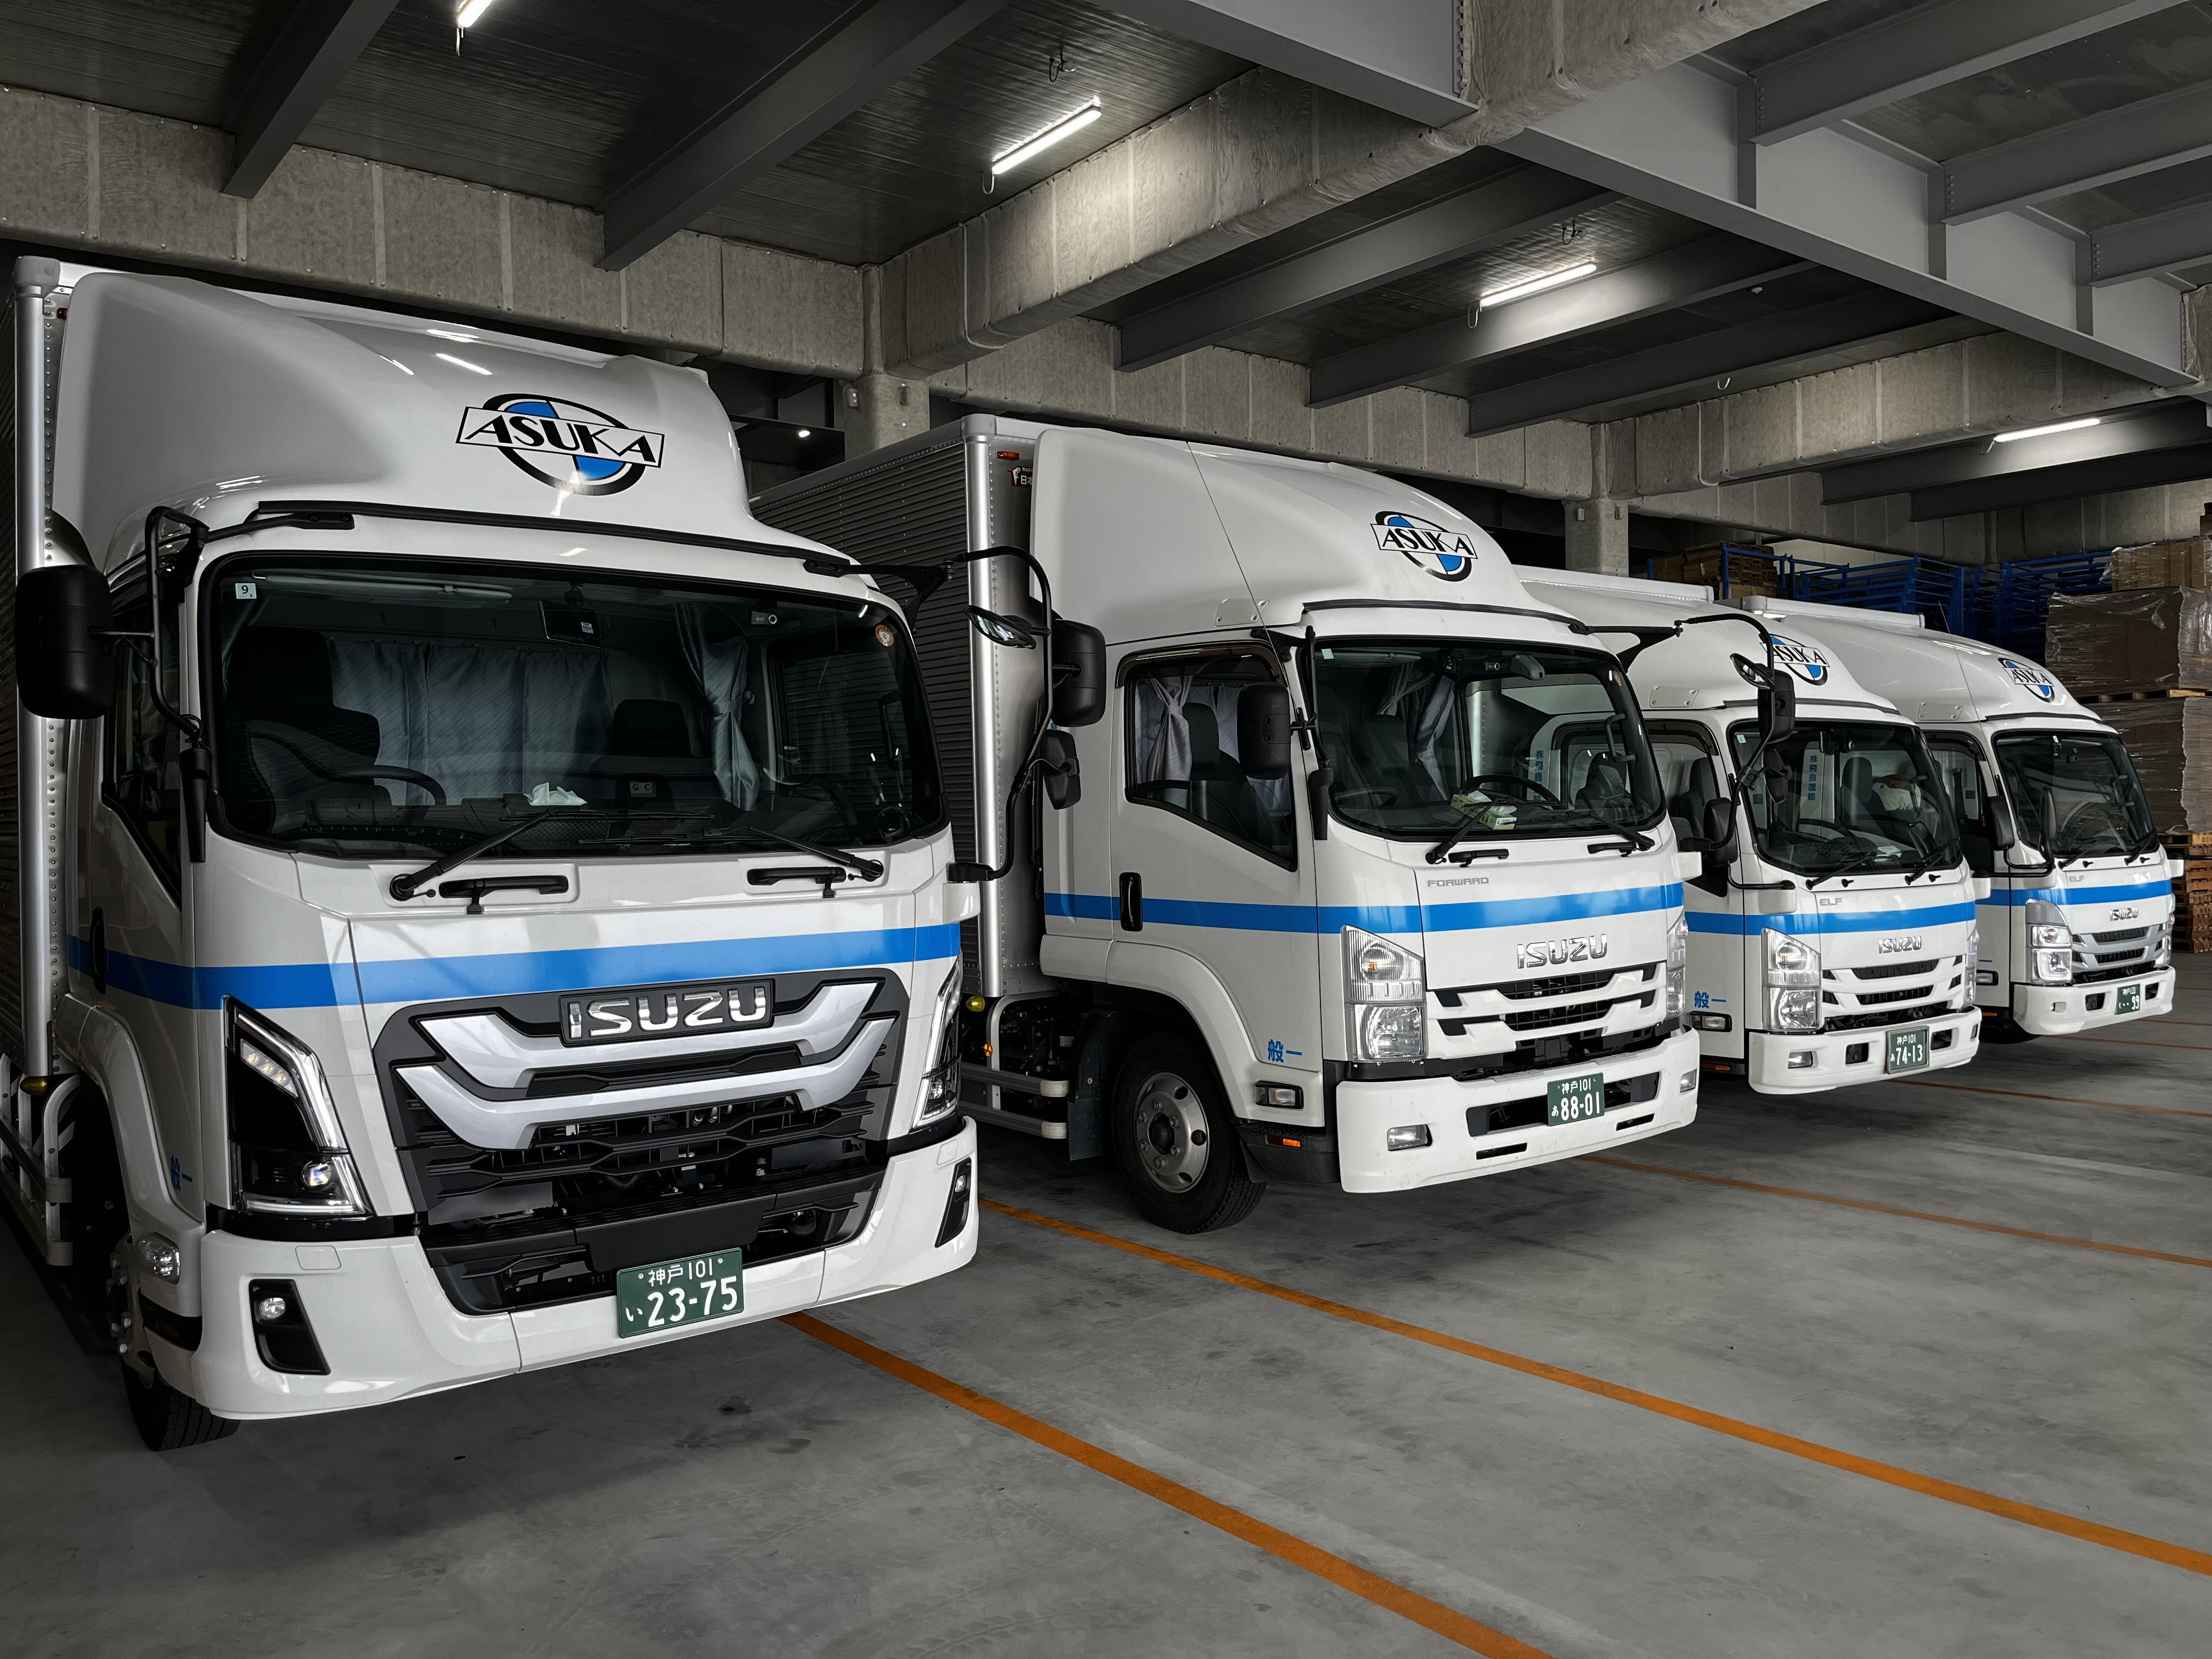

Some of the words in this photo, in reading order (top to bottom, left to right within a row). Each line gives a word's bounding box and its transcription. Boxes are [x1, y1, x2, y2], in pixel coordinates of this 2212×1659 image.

[466, 414, 657, 463] ASUKA
[1381, 526, 1475, 557] ASUKA
[241, 585, 249, 594] 9
[2011, 669, 2052, 685] ASUKA
[1427, 877, 1489, 887] FORWARD
[1819, 898, 1842, 906] ELF
[2109, 907, 2138, 922] ISUZU
[1516, 934, 1607, 969] ISUZU
[1878, 935, 1922, 954] ISUZU
[568, 985, 766, 1040] ISUZU
[1897, 1035, 1908, 1046] 神戸
[1908, 1034, 1916, 1044] 101
[1890, 1053, 1895, 1062] あ
[1895, 1044, 1923, 1065] 74-13
[1561, 1081, 1578, 1094] 神戸
[1579, 1077, 1591, 1092] 101
[1551, 1105, 1559, 1116] あ
[1561, 1091, 1600, 1121] 88-01
[648, 1264, 684, 1287] 神戸
[689, 1258, 713, 1280] 101
[625, 1307, 643, 1322] い
[647, 1276, 737, 1328] 23-75
